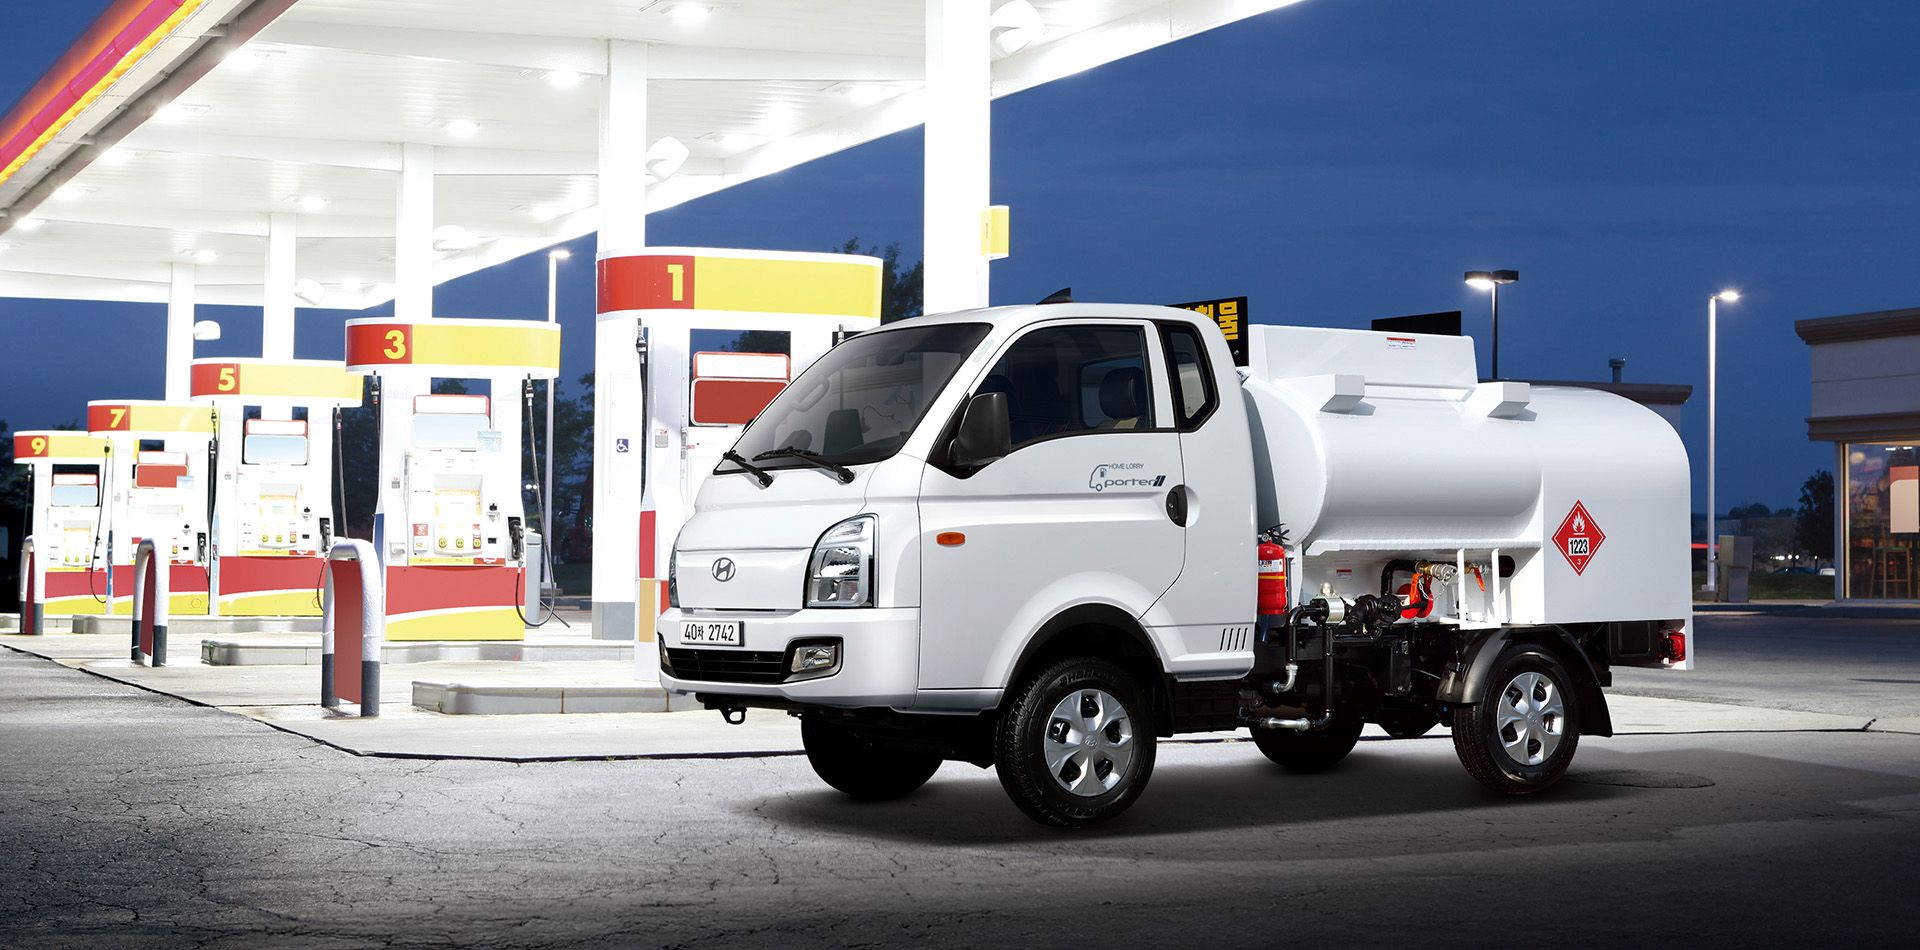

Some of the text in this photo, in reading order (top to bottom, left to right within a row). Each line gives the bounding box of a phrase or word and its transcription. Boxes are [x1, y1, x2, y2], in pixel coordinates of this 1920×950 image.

[667, 264, 685, 301] 1
[383, 329, 406, 360] 3
[218, 368, 236, 391] 5
[109, 408, 127, 428] 7
[31, 437, 46, 455] 9
[1570, 539, 1588, 554] 1223
[684, 623, 734, 642] 40차 2742
